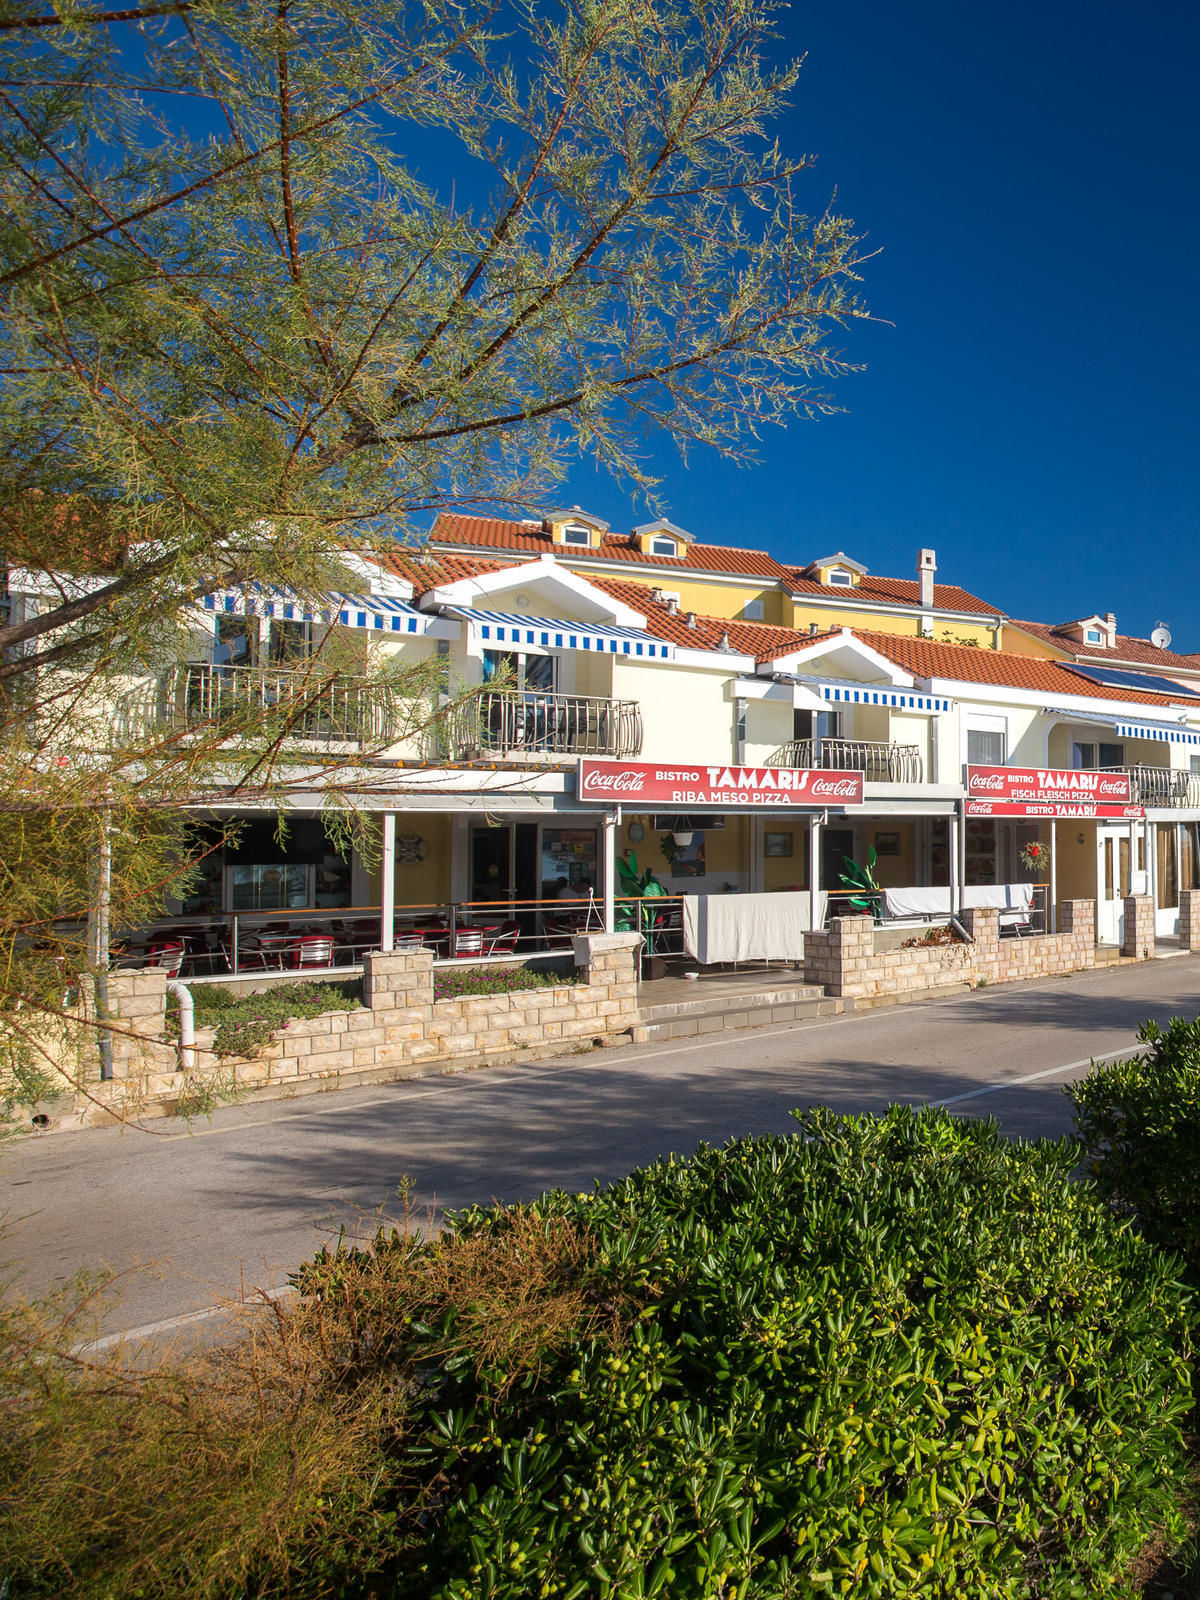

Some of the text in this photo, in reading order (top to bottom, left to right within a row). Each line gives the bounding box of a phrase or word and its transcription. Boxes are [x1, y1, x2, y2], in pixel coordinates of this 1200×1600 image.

[584, 770, 647, 792] Coca-Cola
[656, 767, 810, 790] BISTRO TAMARIS
[969, 774, 1005, 790] Coca-Cola
[1007, 772, 1099, 790] BISTRO TAMARIS
[811, 778, 858, 797] Coca-Cola
[1011, 789, 1094, 800] FISCH FLEISCH PIZZA
[672, 791, 791, 803] RIBA MESO PIZZA
[1025, 804, 1097, 817] BISTRO TAMARIS
